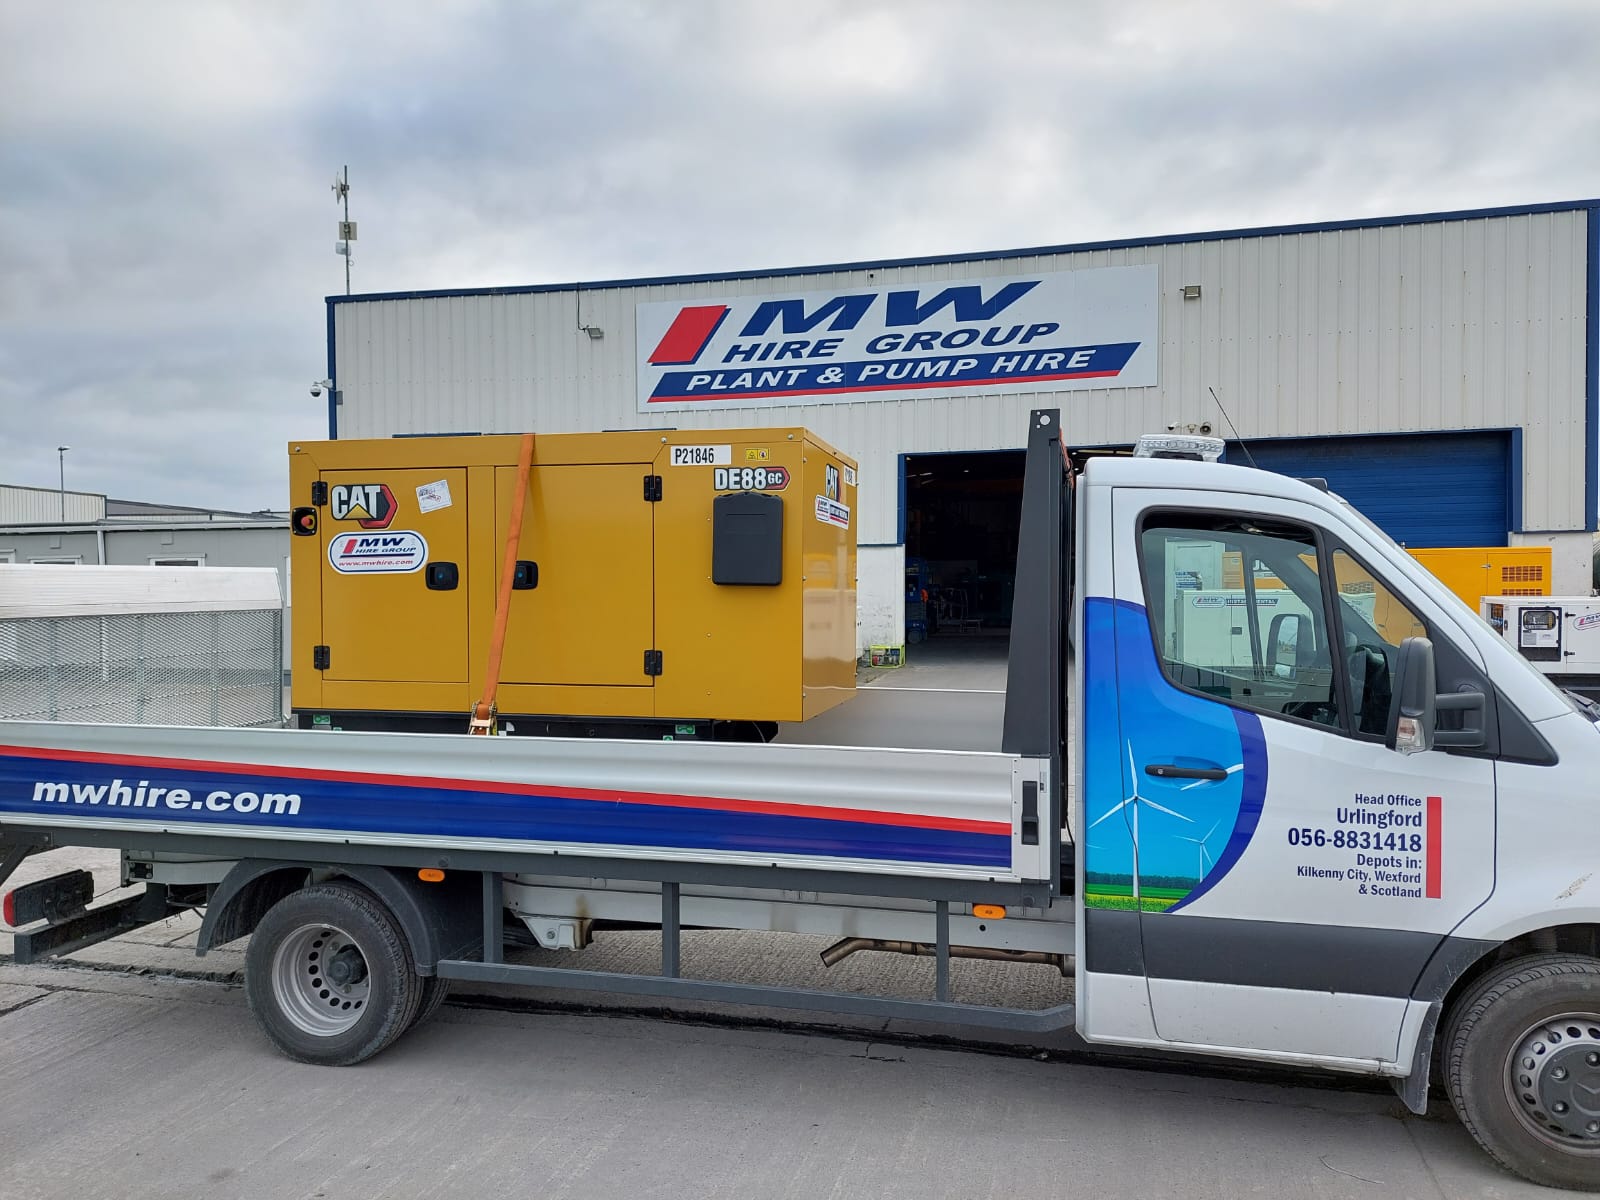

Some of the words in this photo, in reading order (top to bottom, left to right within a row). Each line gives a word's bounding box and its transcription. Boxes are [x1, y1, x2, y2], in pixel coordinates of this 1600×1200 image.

[738, 280, 1042, 337] MW
[721, 337, 845, 363] HIRE
[865, 322, 1060, 355] GROUP
[685, 368, 802, 391] PLANT
[815, 366, 846, 385] &
[856, 357, 979, 382] PUMP
[990, 349, 1098, 374] HIRE
[674, 447, 715, 464] P21846
[331, 484, 381, 520] CAT
[358, 537, 406, 548] MW
[338, 559, 414, 567] www.mwhire.com
[32, 779, 302, 815] mwhire.com
[1355, 793, 1384, 805] Head
[1387, 794, 1422, 807] Office
[1336, 807, 1422, 829] Urlingford
[1288, 827, 1422, 852] 056-8831418
[1357, 853, 1402, 869] Depots
[1405, 857, 1422, 869] in:
[1297, 866, 1344, 881] Kilkenny
[1347, 868, 1372, 882] City,
[1374, 871, 1421, 883] Wexford
[1358, 883, 1368, 895] &
[1371, 885, 1421, 898] Scotland
